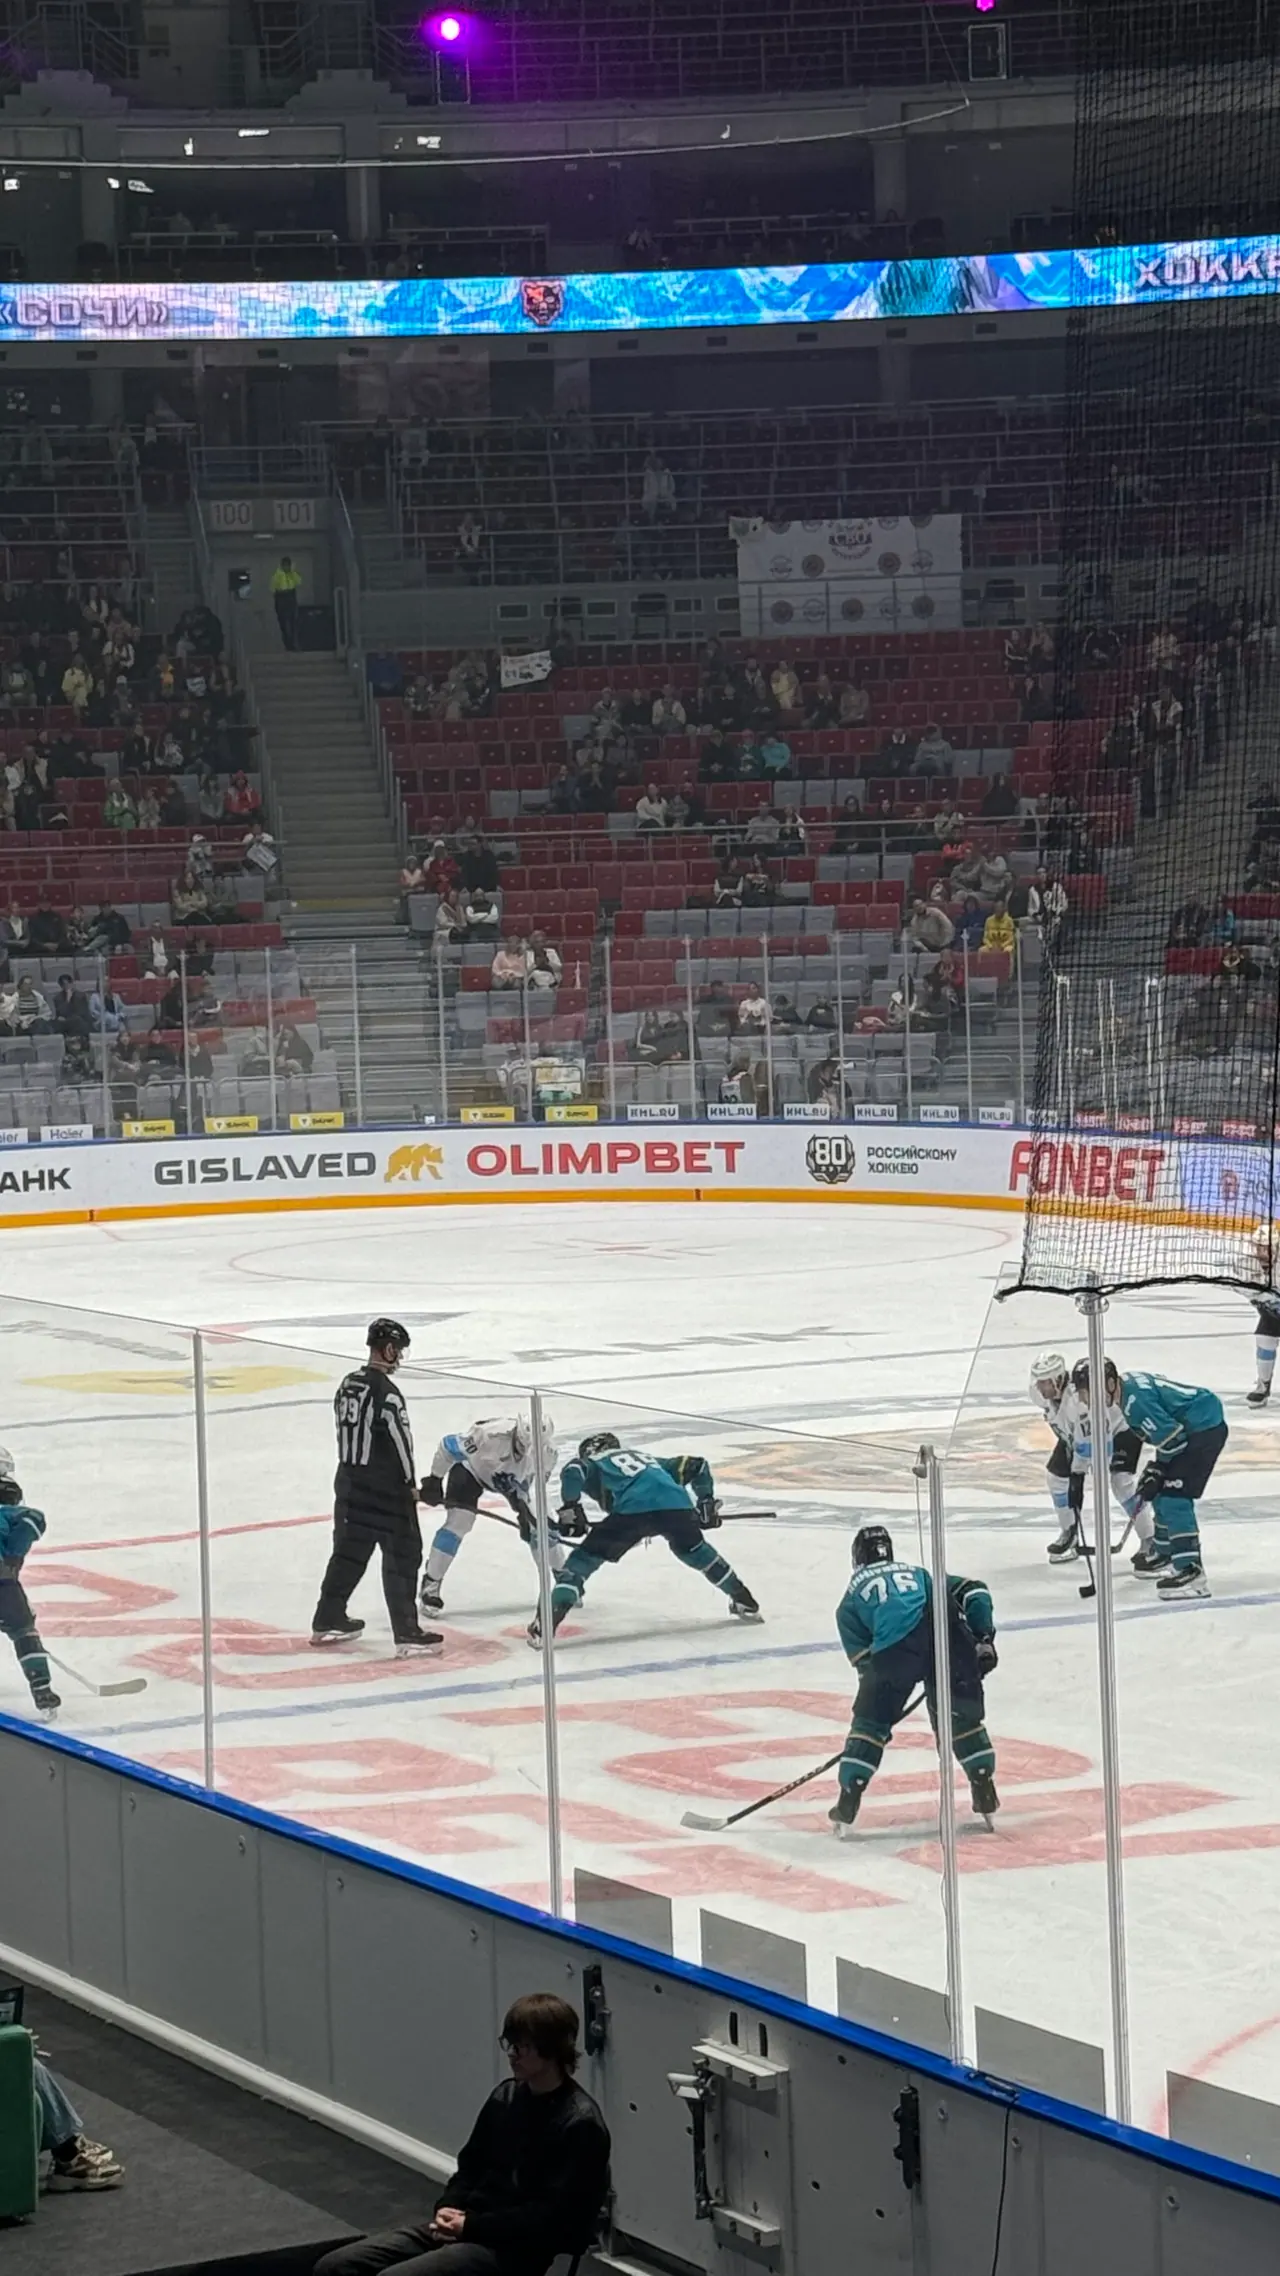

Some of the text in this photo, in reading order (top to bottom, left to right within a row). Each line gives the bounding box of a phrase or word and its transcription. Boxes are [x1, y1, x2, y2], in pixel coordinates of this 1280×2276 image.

[213, 502, 251, 525] 100
[276, 502, 311, 523] 101
[710, 1107, 754, 1117] KHL.RU
[50, 1128, 84, 1140] Haier
[466, 1141, 745, 1177] OLIMPBET
[815, 1138, 847, 1165] 80
[867, 1145, 957, 1161] РОССИЙСКОМУ
[154, 1152, 376, 1185] GISLAVED
[867, 1162, 919, 1175] ХОККЕЮ
[1008, 1140, 1165, 1202] FONBET
